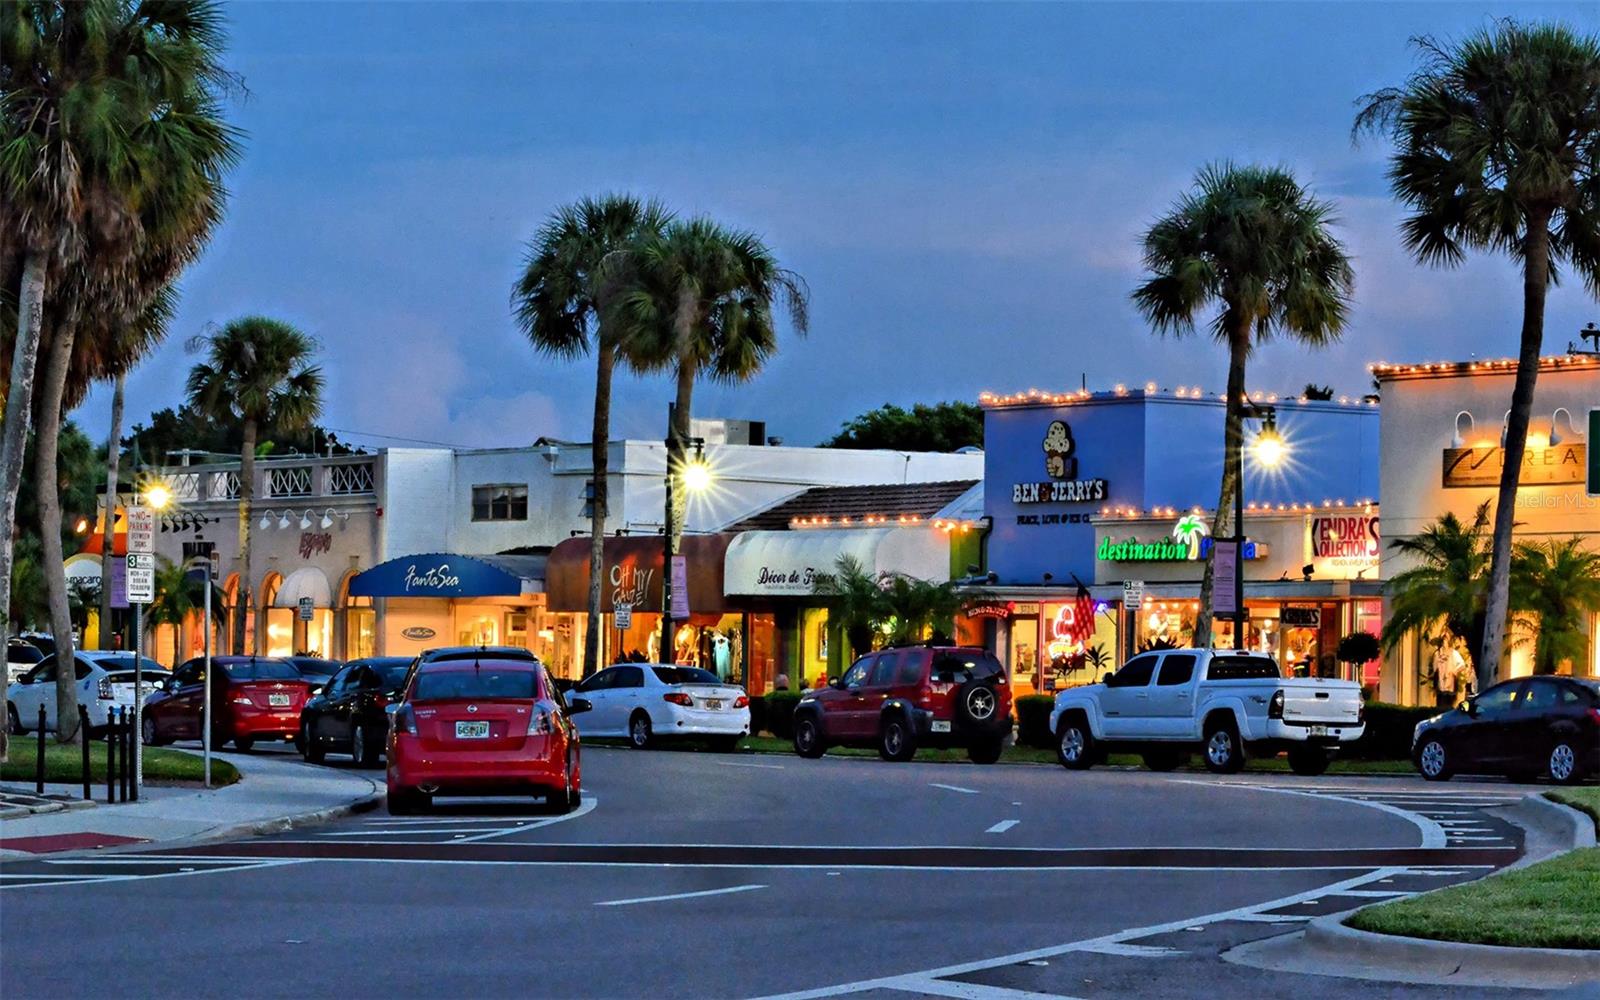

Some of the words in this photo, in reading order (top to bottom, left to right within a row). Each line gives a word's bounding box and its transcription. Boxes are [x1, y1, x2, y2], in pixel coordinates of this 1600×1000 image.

[1013, 483, 1039, 502] BEN
[1050, 480, 1103, 501] JERRY'S
[136, 511, 146, 520] NO
[129, 521, 152, 531] PARKING
[1098, 535, 1187, 561] destination
[128, 555, 136, 567] 3
[404, 564, 460, 591] FantaSea
[610, 564, 630, 588] OH
[633, 567, 648, 592] MY
[789, 570, 800, 584] de
